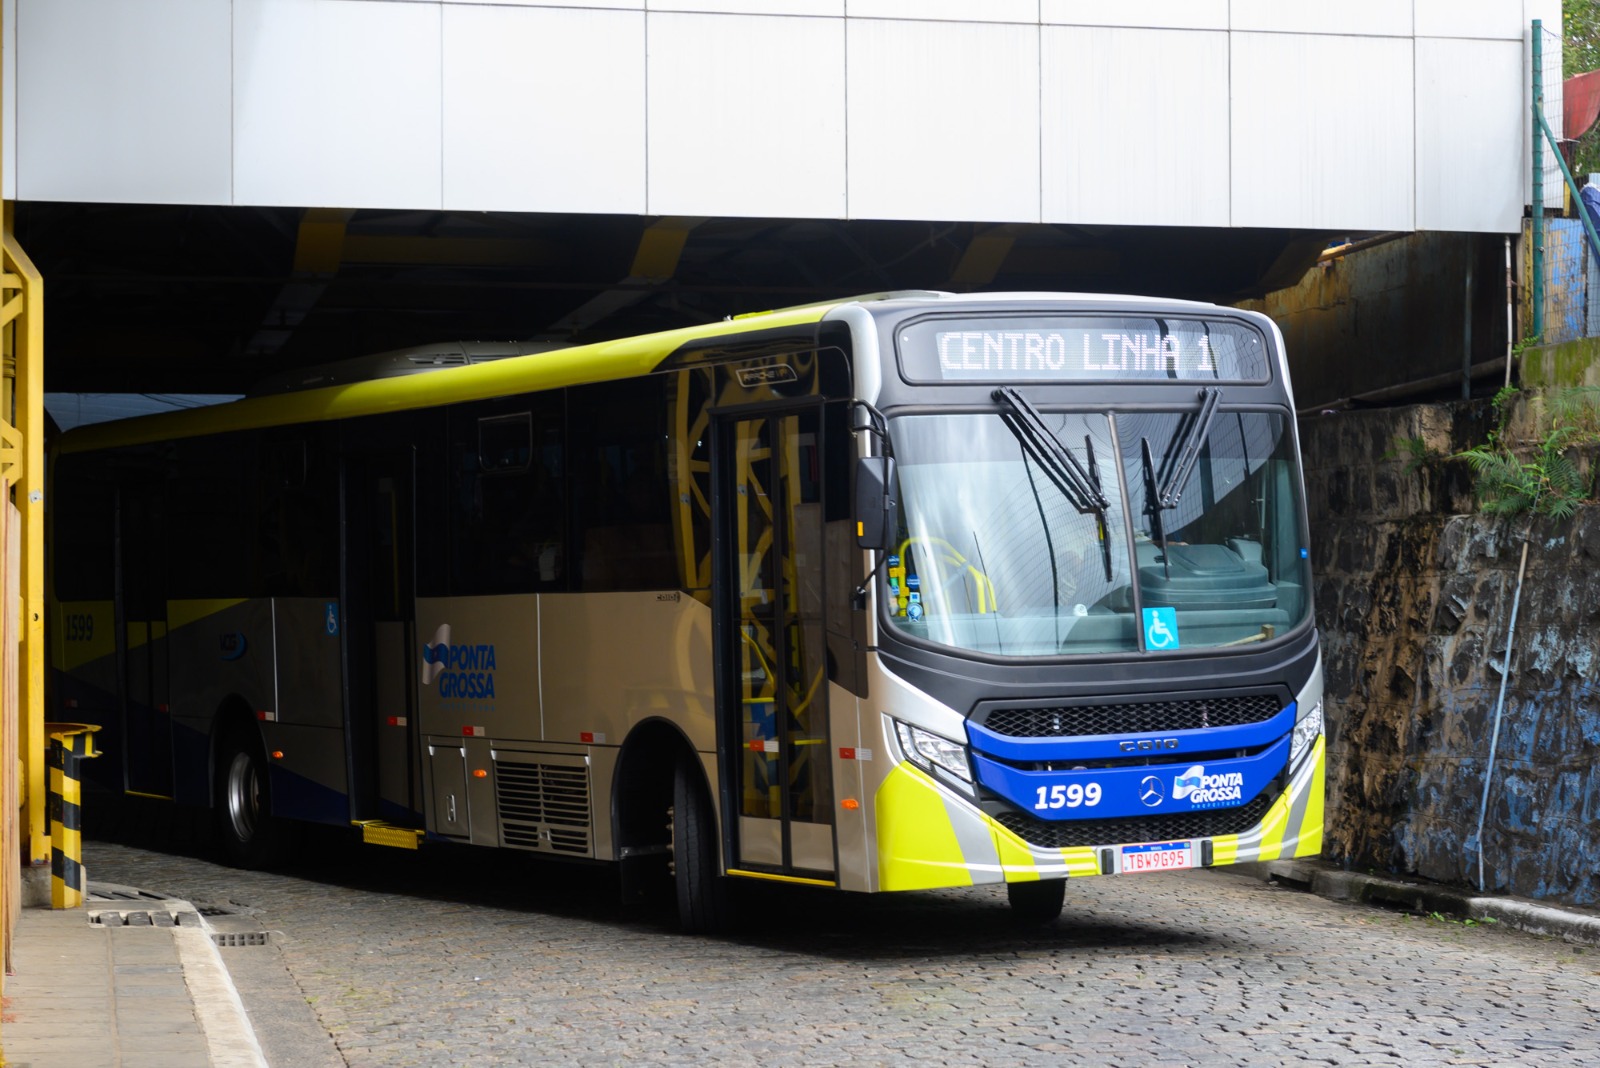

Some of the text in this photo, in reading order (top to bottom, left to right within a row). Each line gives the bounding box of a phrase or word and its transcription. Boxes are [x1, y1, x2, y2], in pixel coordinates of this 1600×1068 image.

[941, 332, 1213, 371] CENTRO LINHA 1
[66, 614, 93, 641] 1599
[449, 644, 496, 670] PONTA
[439, 672, 495, 698] GROSSA
[1201, 772, 1243, 789] PONTA
[1035, 783, 1102, 810] 1599
[1190, 786, 1241, 803] GROSSA
[1129, 850, 1184, 870] TBW9G95
